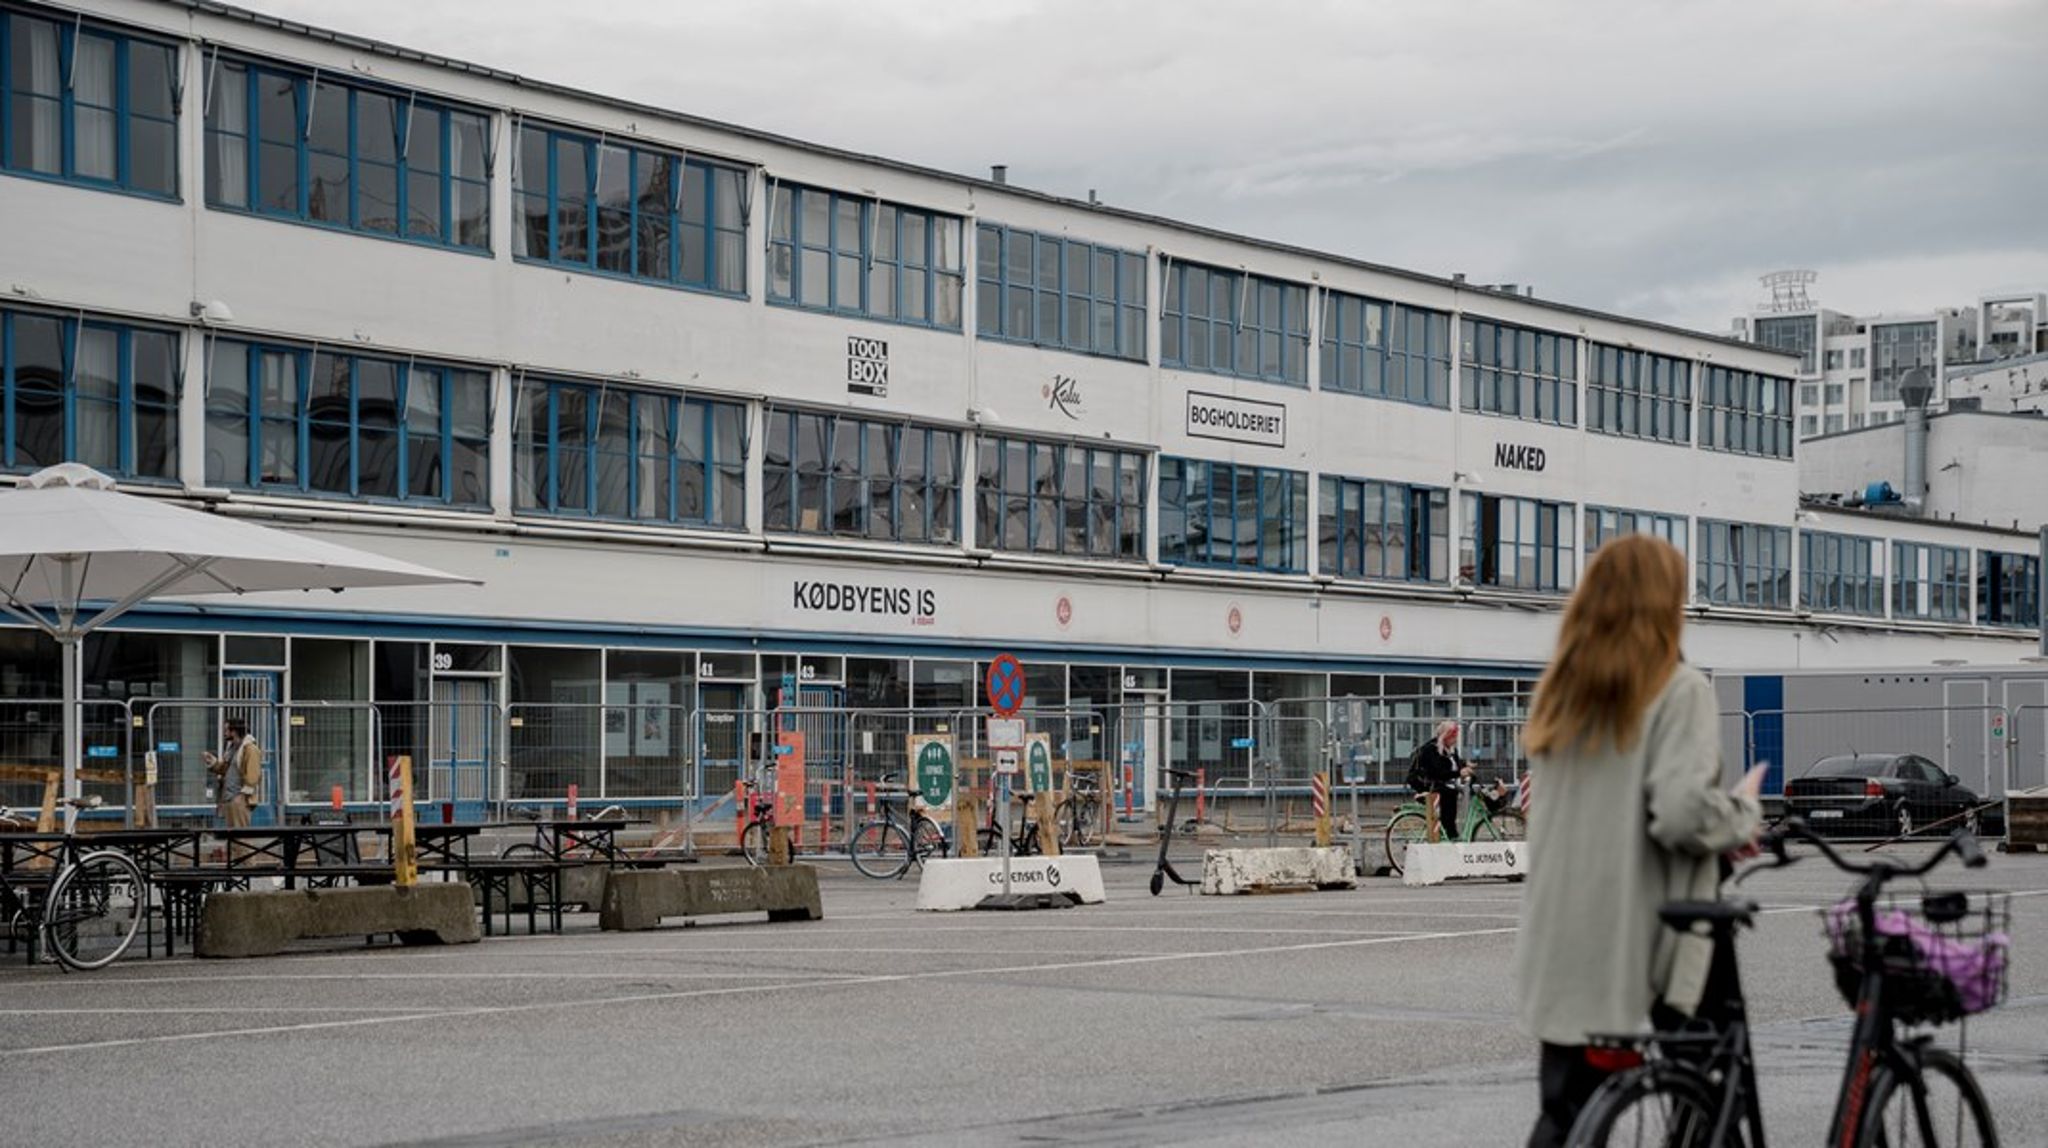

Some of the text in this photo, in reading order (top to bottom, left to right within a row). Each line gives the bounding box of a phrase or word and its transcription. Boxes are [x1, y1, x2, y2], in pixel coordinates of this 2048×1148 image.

[849, 338, 887, 359] TOOL
[851, 360, 886, 384] BOX
[1192, 405, 1280, 434] BOGHOLDERIET
[1495, 443, 1546, 472] NAKED
[794, 581, 935, 616] KØDBYENS IS
[435, 653, 452, 669] 39
[701, 662, 713, 676] 41
[801, 665, 815, 679] 43
[1004, 870, 1044, 883] ENSEN
